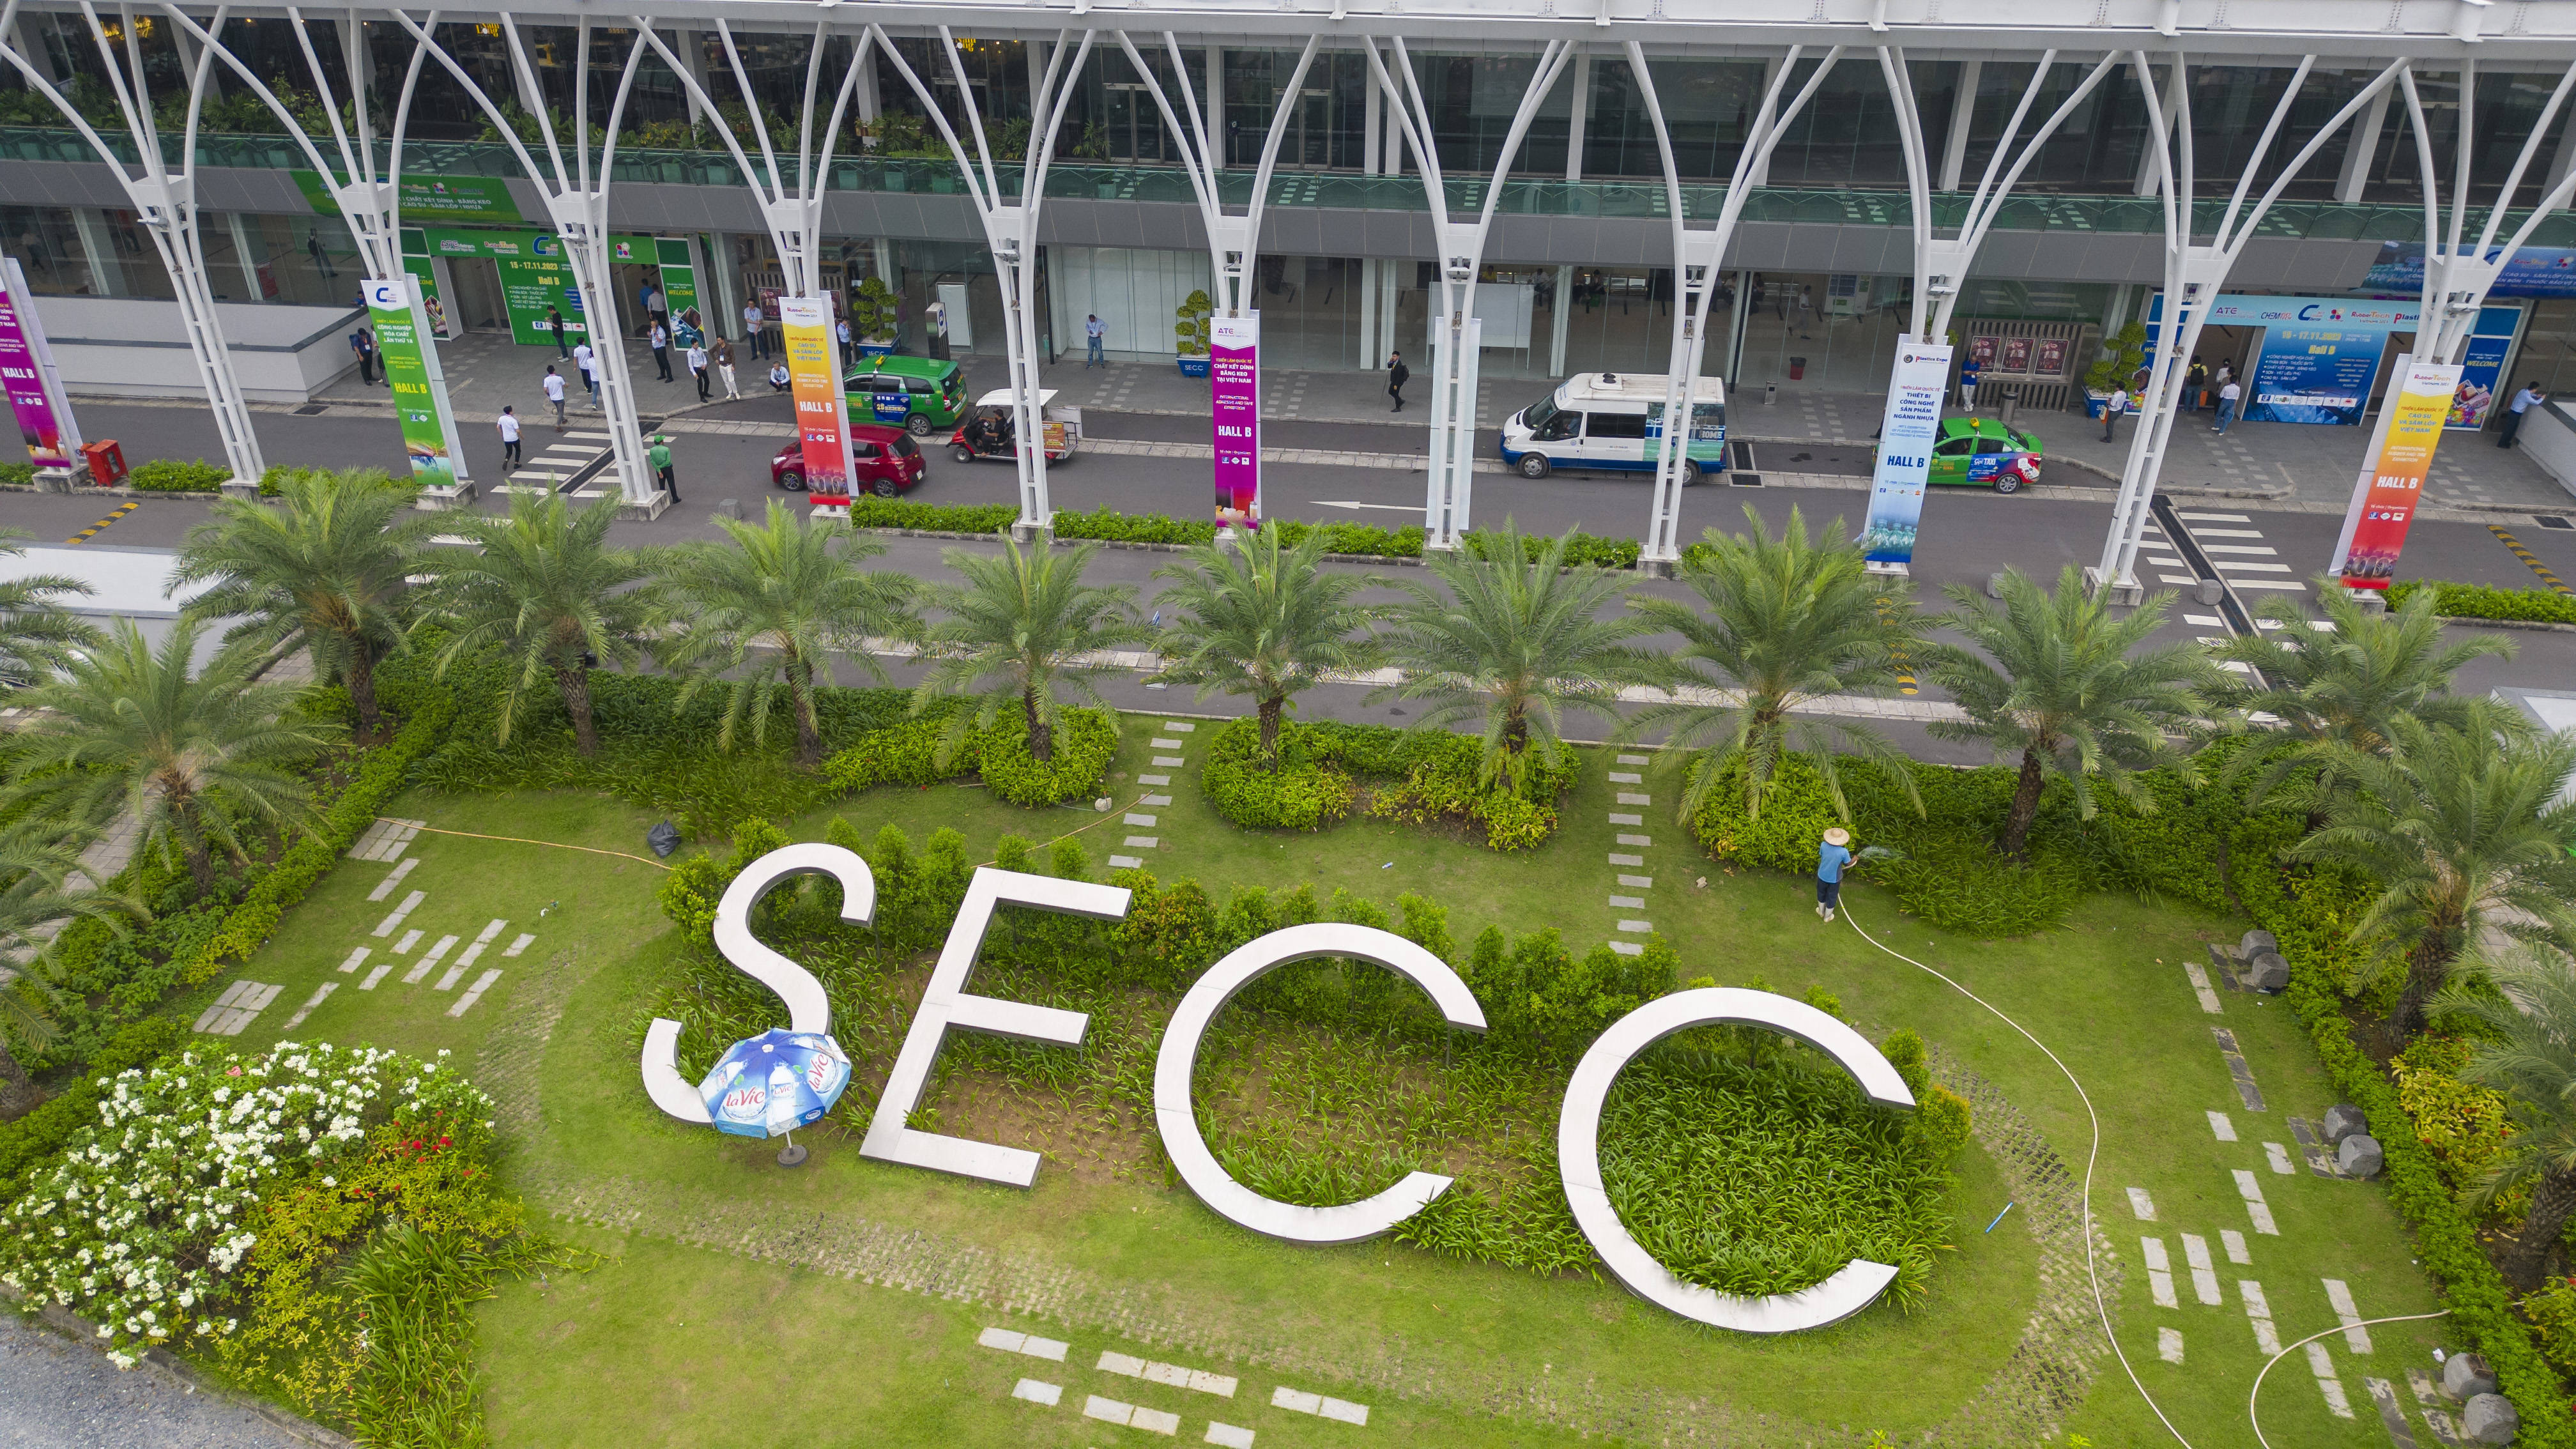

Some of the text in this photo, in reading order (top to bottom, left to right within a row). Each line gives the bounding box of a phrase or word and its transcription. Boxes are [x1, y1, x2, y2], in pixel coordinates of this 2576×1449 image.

[3, 367, 35, 378] HALL B
[394, 382, 427, 394] HALL B
[799, 401, 833, 413] HALL B
[1218, 425, 1252, 437] HALL B
[1887, 455, 1913, 467] HALL
[1917, 457, 1925, 468] B
[1983, 457, 1996, 466] TAXI
[2377, 476, 2418, 489] HALL B
[808, 1053, 830, 1090] laVie
[641, 843, 1917, 1334] SECC
[726, 1086, 765, 1107] laVie
